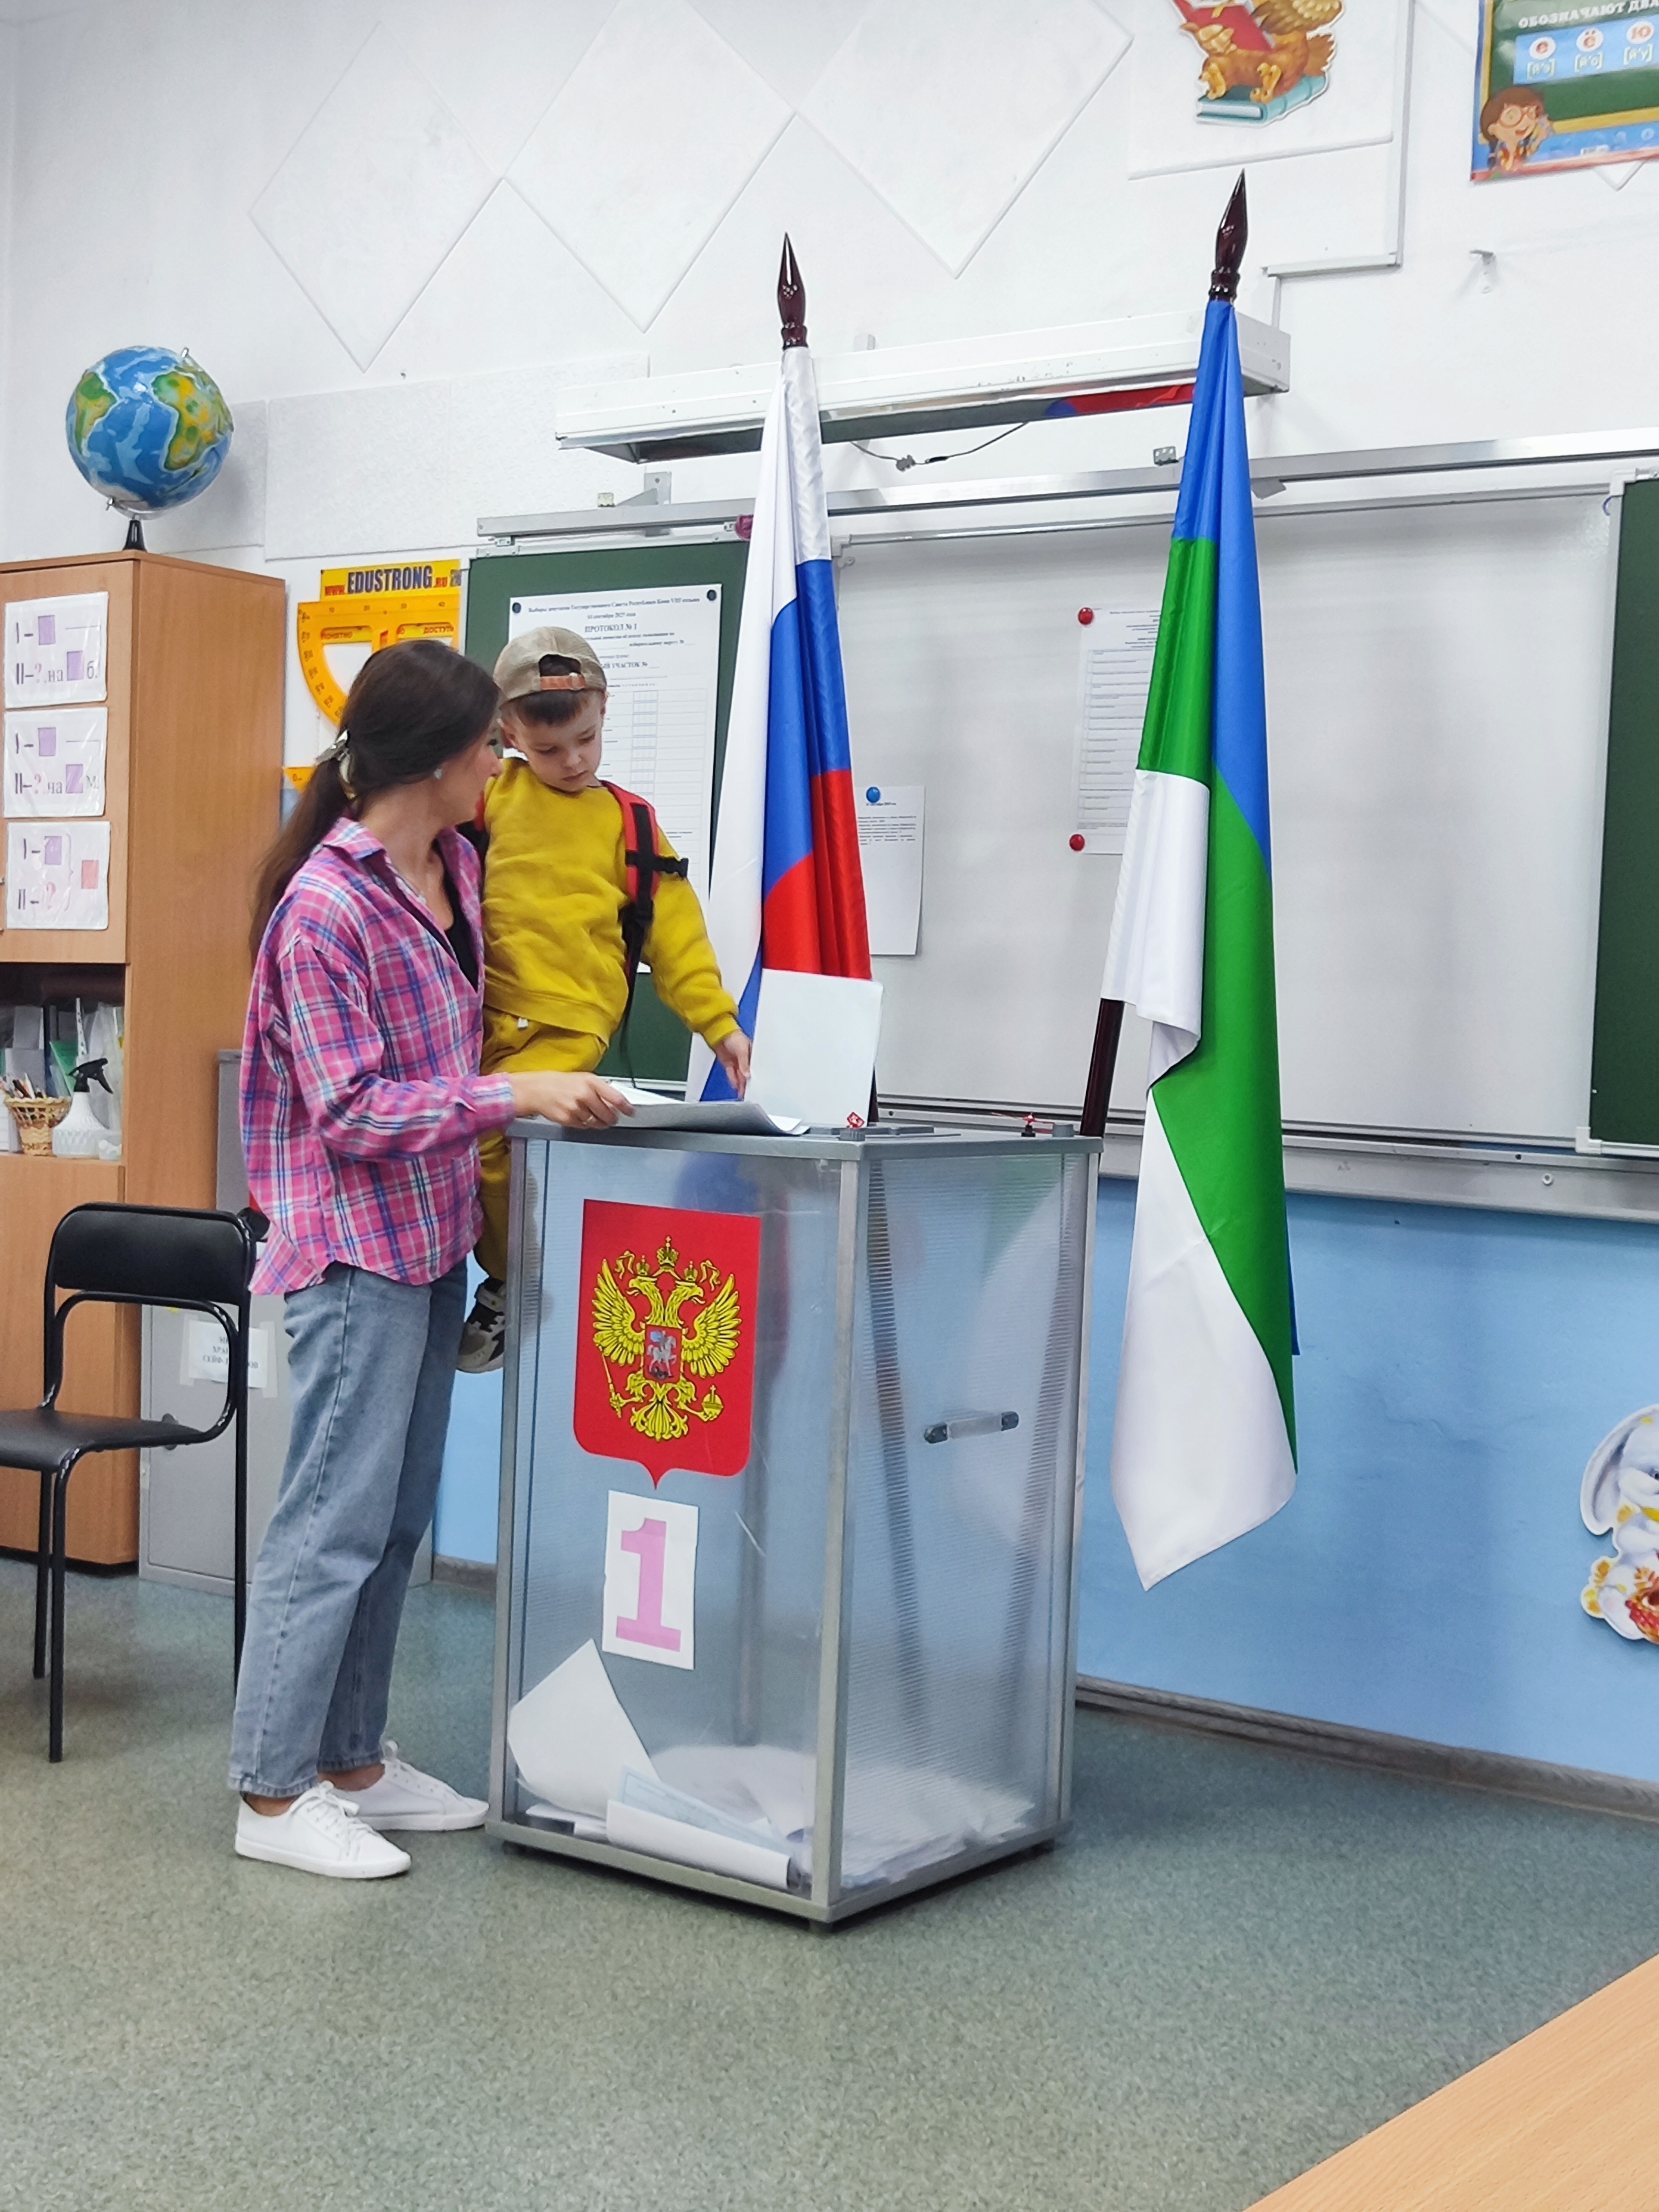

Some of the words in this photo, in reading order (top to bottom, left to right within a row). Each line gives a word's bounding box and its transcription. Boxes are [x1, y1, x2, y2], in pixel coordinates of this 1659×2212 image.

[1518, 2, 1626, 28] ОБОЗНАЧАЮТ
[585, 624, 624, 633] ПРОТОКОЛ
[616, 1517, 681, 1652] 1
